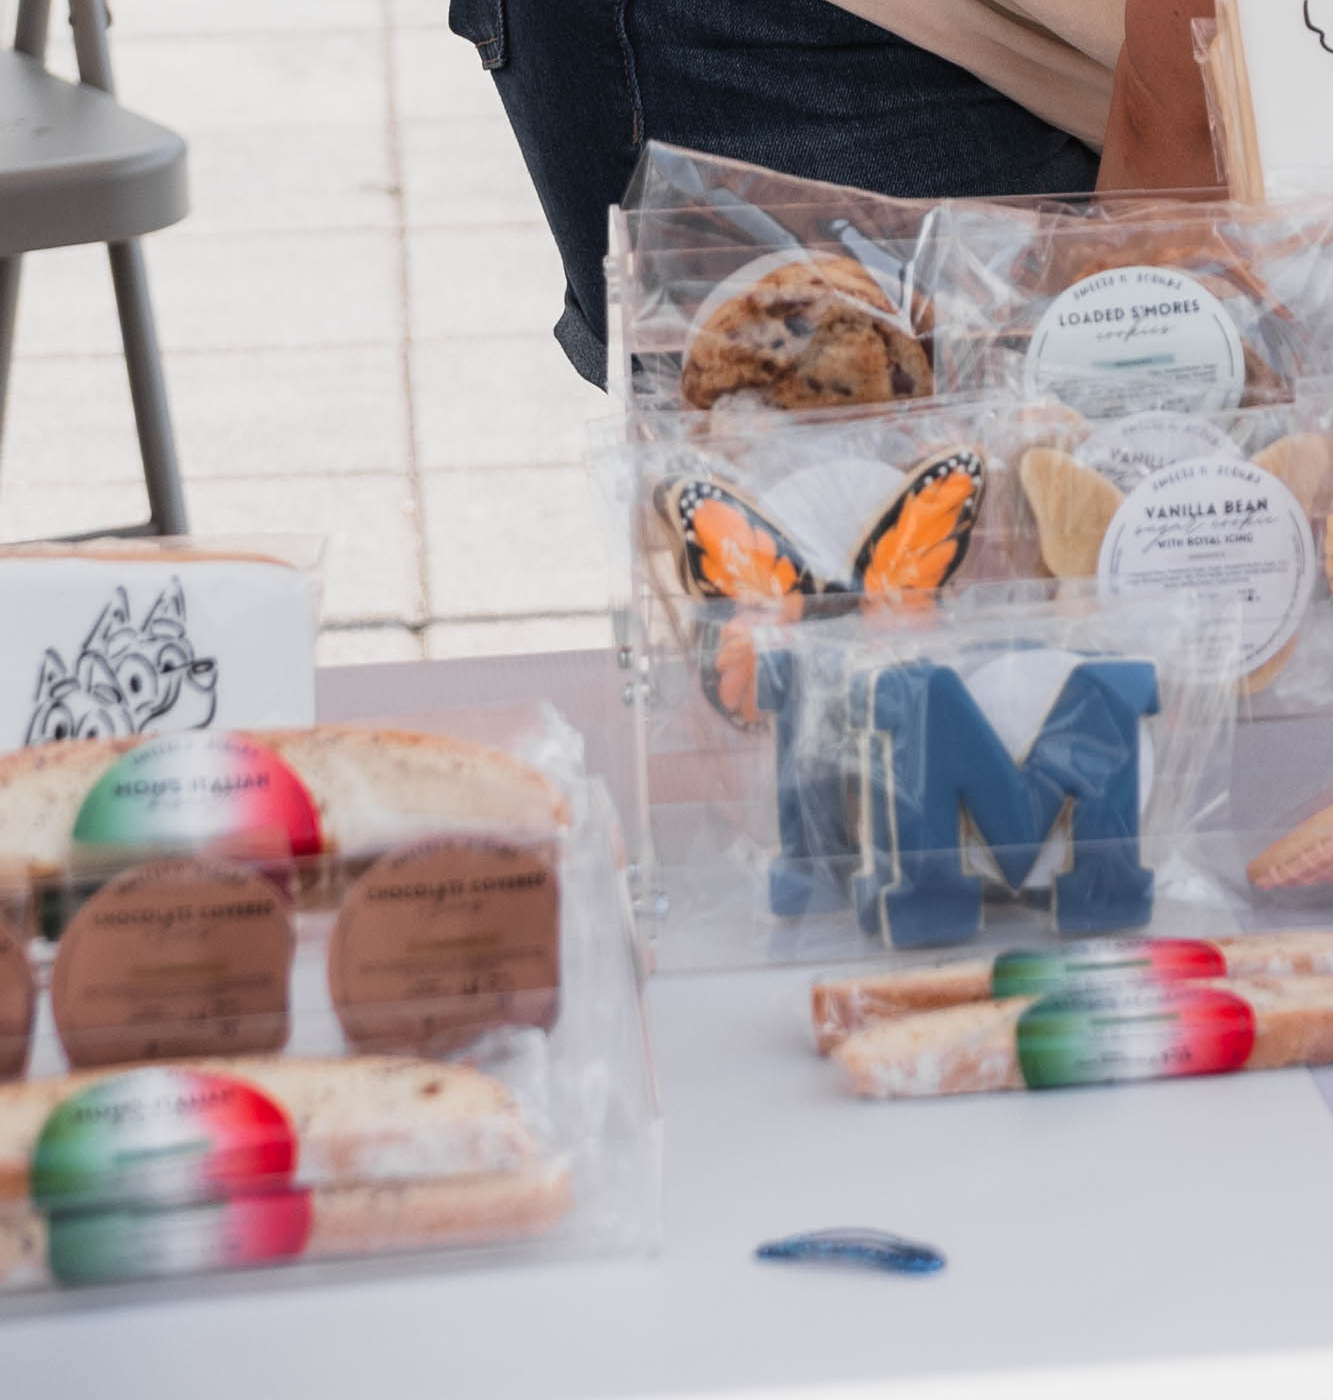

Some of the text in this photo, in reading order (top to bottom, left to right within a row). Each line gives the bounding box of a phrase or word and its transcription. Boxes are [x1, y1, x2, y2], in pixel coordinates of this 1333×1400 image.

[1058, 307, 1125, 327] LOADED
[1144, 498, 1268, 519] VANILLA BEAN
